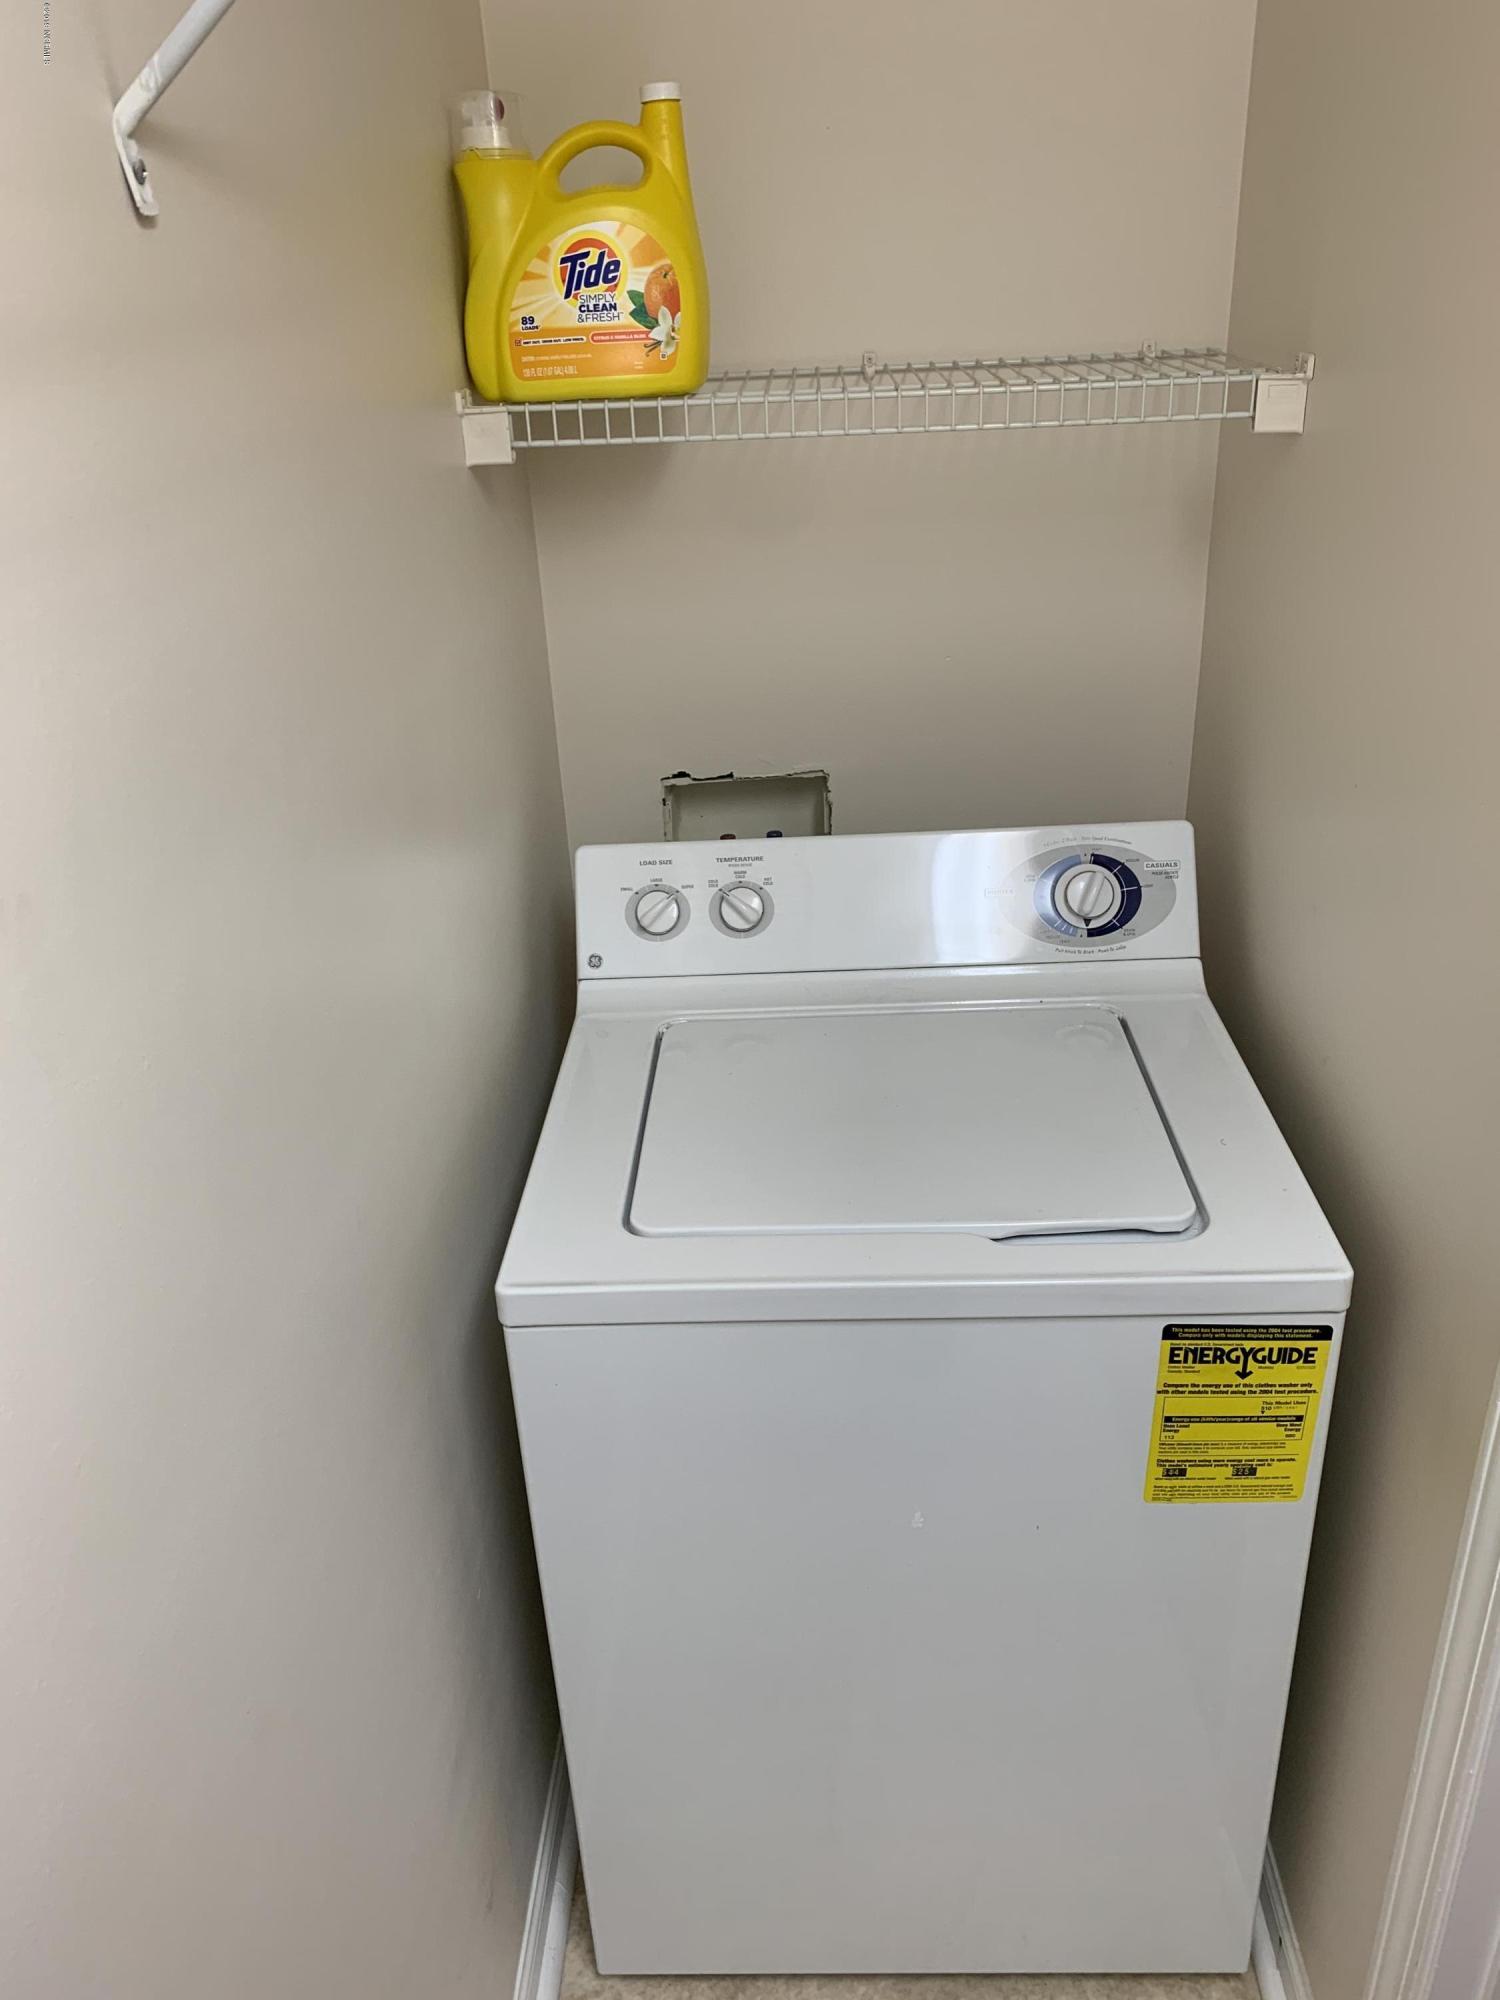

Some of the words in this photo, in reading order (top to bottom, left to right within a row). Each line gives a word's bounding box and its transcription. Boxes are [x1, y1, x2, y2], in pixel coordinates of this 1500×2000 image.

[559, 250, 621, 300] Tide
[579, 293, 616, 304] SIMPLY
[578, 303, 617, 313] CLEAN
[521, 315, 535, 325] 89
[1168, 1346, 1318, 1365] ENERGYGUIDE
